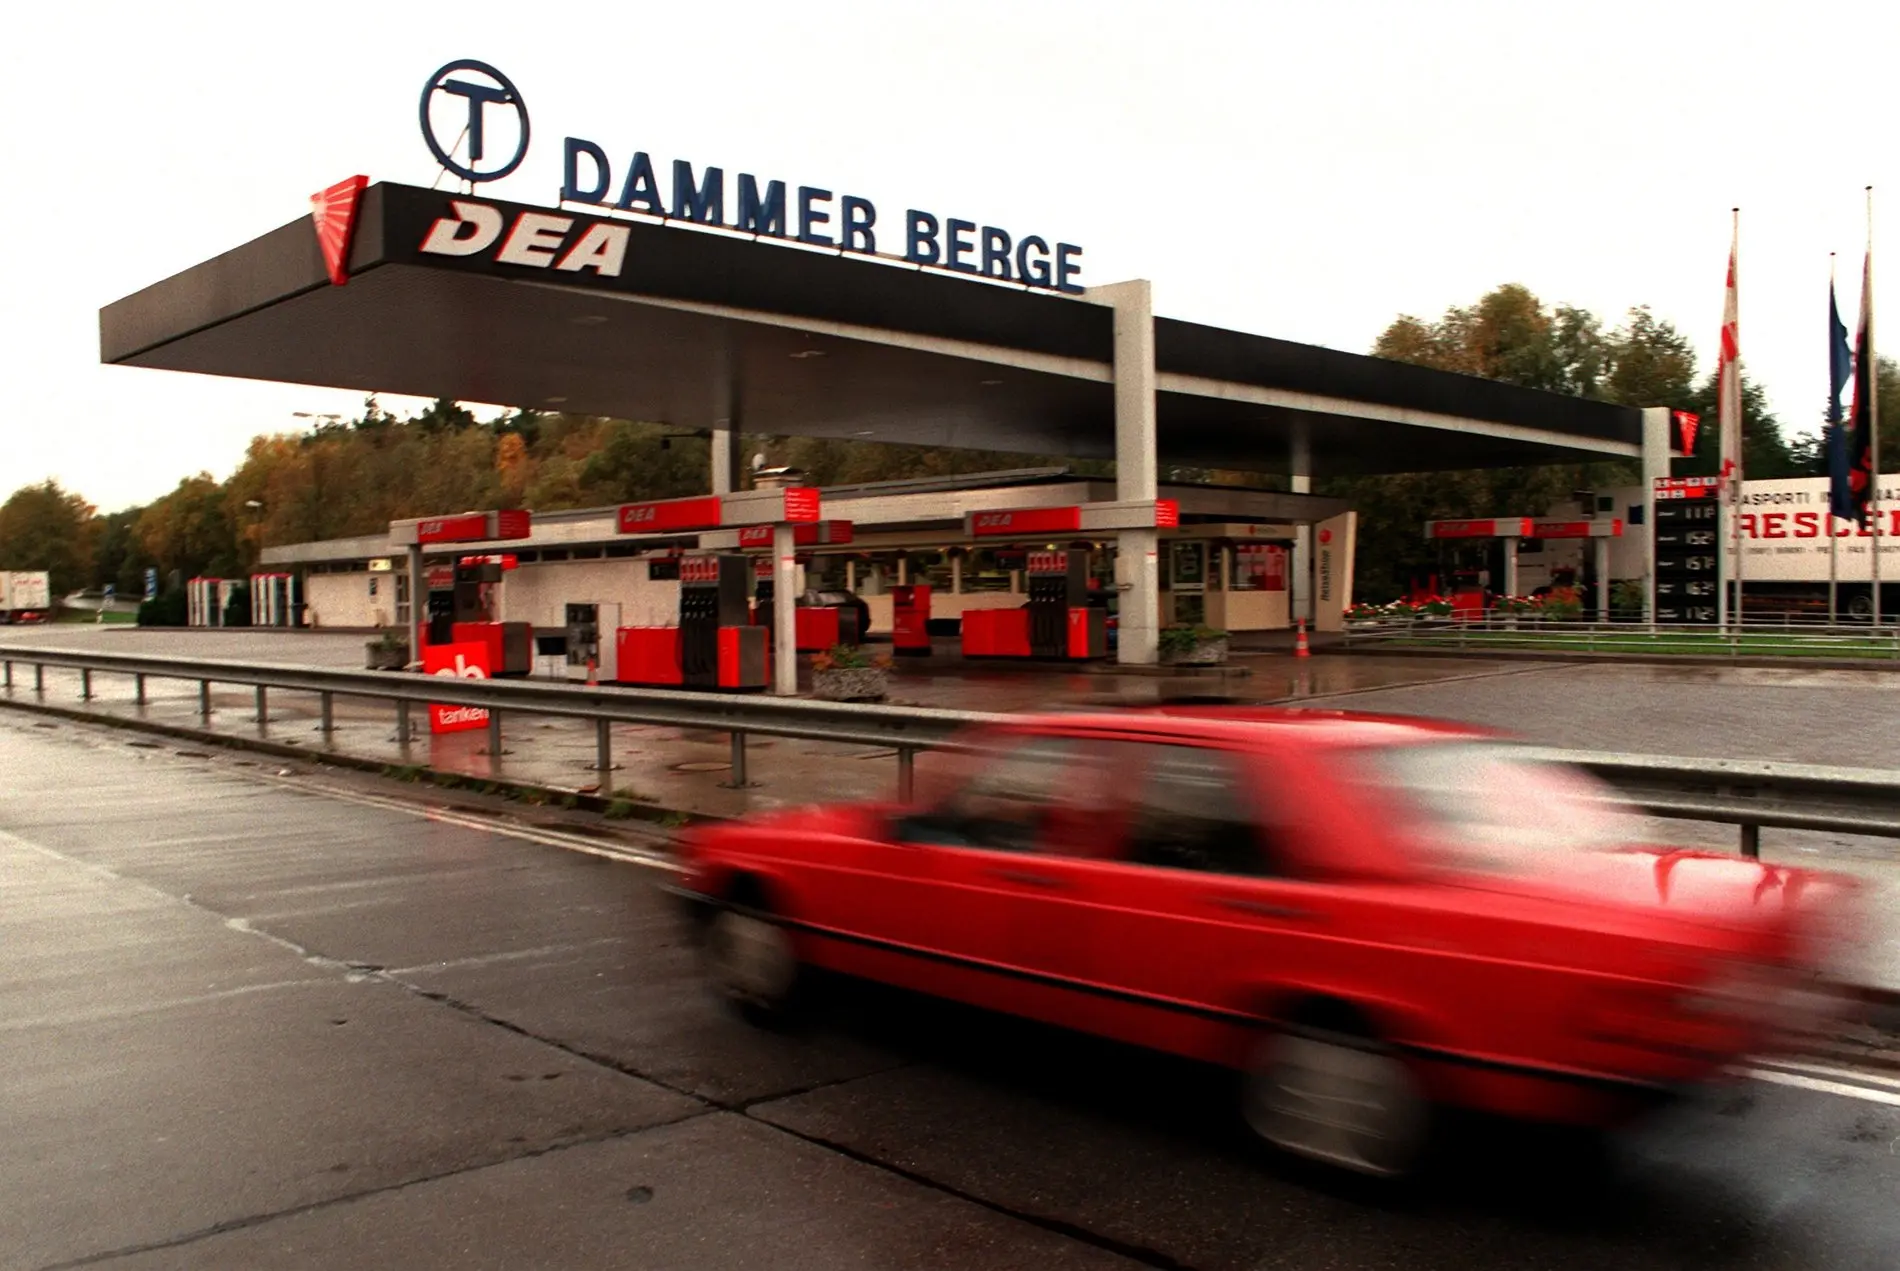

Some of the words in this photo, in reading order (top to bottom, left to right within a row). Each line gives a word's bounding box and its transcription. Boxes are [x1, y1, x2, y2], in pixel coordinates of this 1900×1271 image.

[444, 78, 512, 161] T
[419, 200, 630, 278] DEA
[563, 136, 876, 254] DAMMER
[906, 209, 1084, 294] BERGE
[625, 507, 656, 522] DEA
[978, 514, 1013, 527] DEA
[439, 706, 489, 725] tanken
